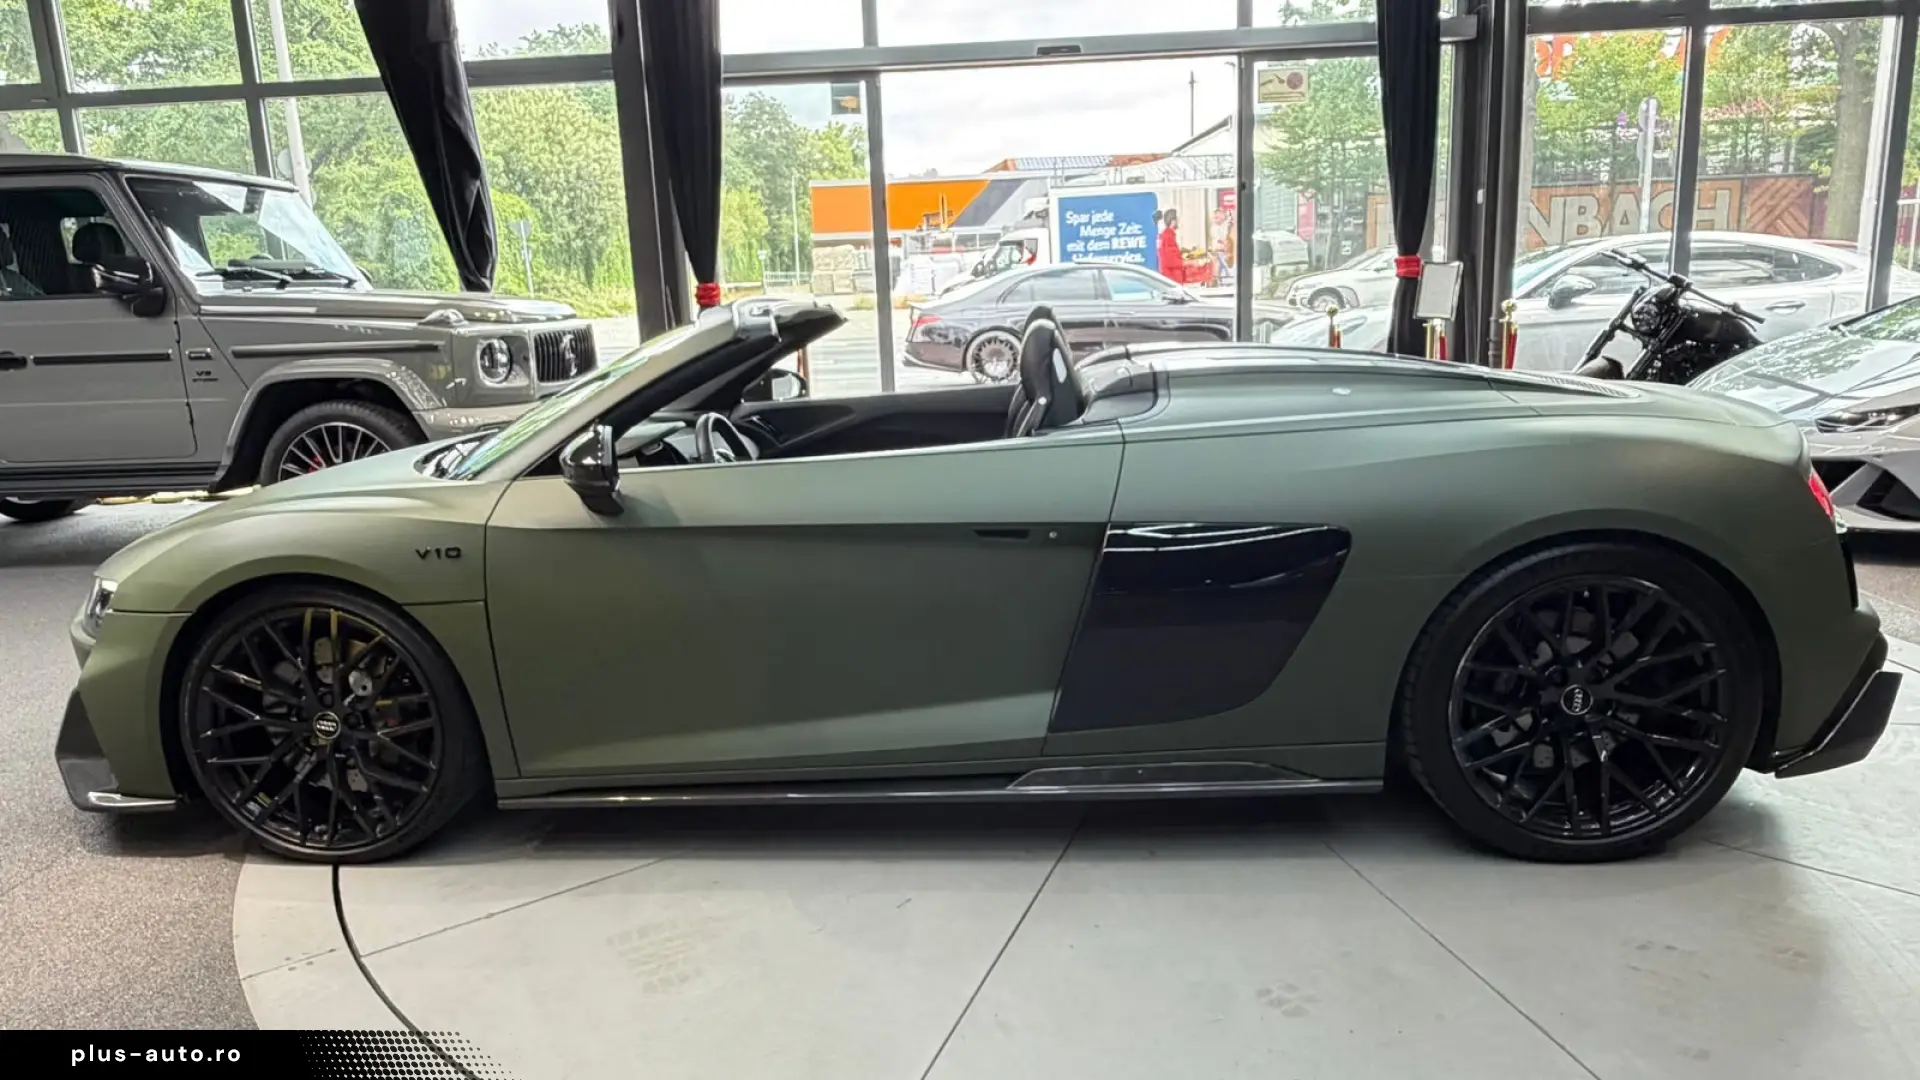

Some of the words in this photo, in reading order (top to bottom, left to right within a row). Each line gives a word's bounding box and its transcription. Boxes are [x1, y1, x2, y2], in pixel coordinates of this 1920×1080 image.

[1065, 210, 1090, 227] Spar
[1091, 208, 1115, 225] jede
[1079, 224, 1117, 239] Menge
[1066, 239, 1085, 252] mit
[1086, 239, 1110, 251] dem
[1110, 235, 1147, 250] REWE
[414, 546, 462, 561] V10
